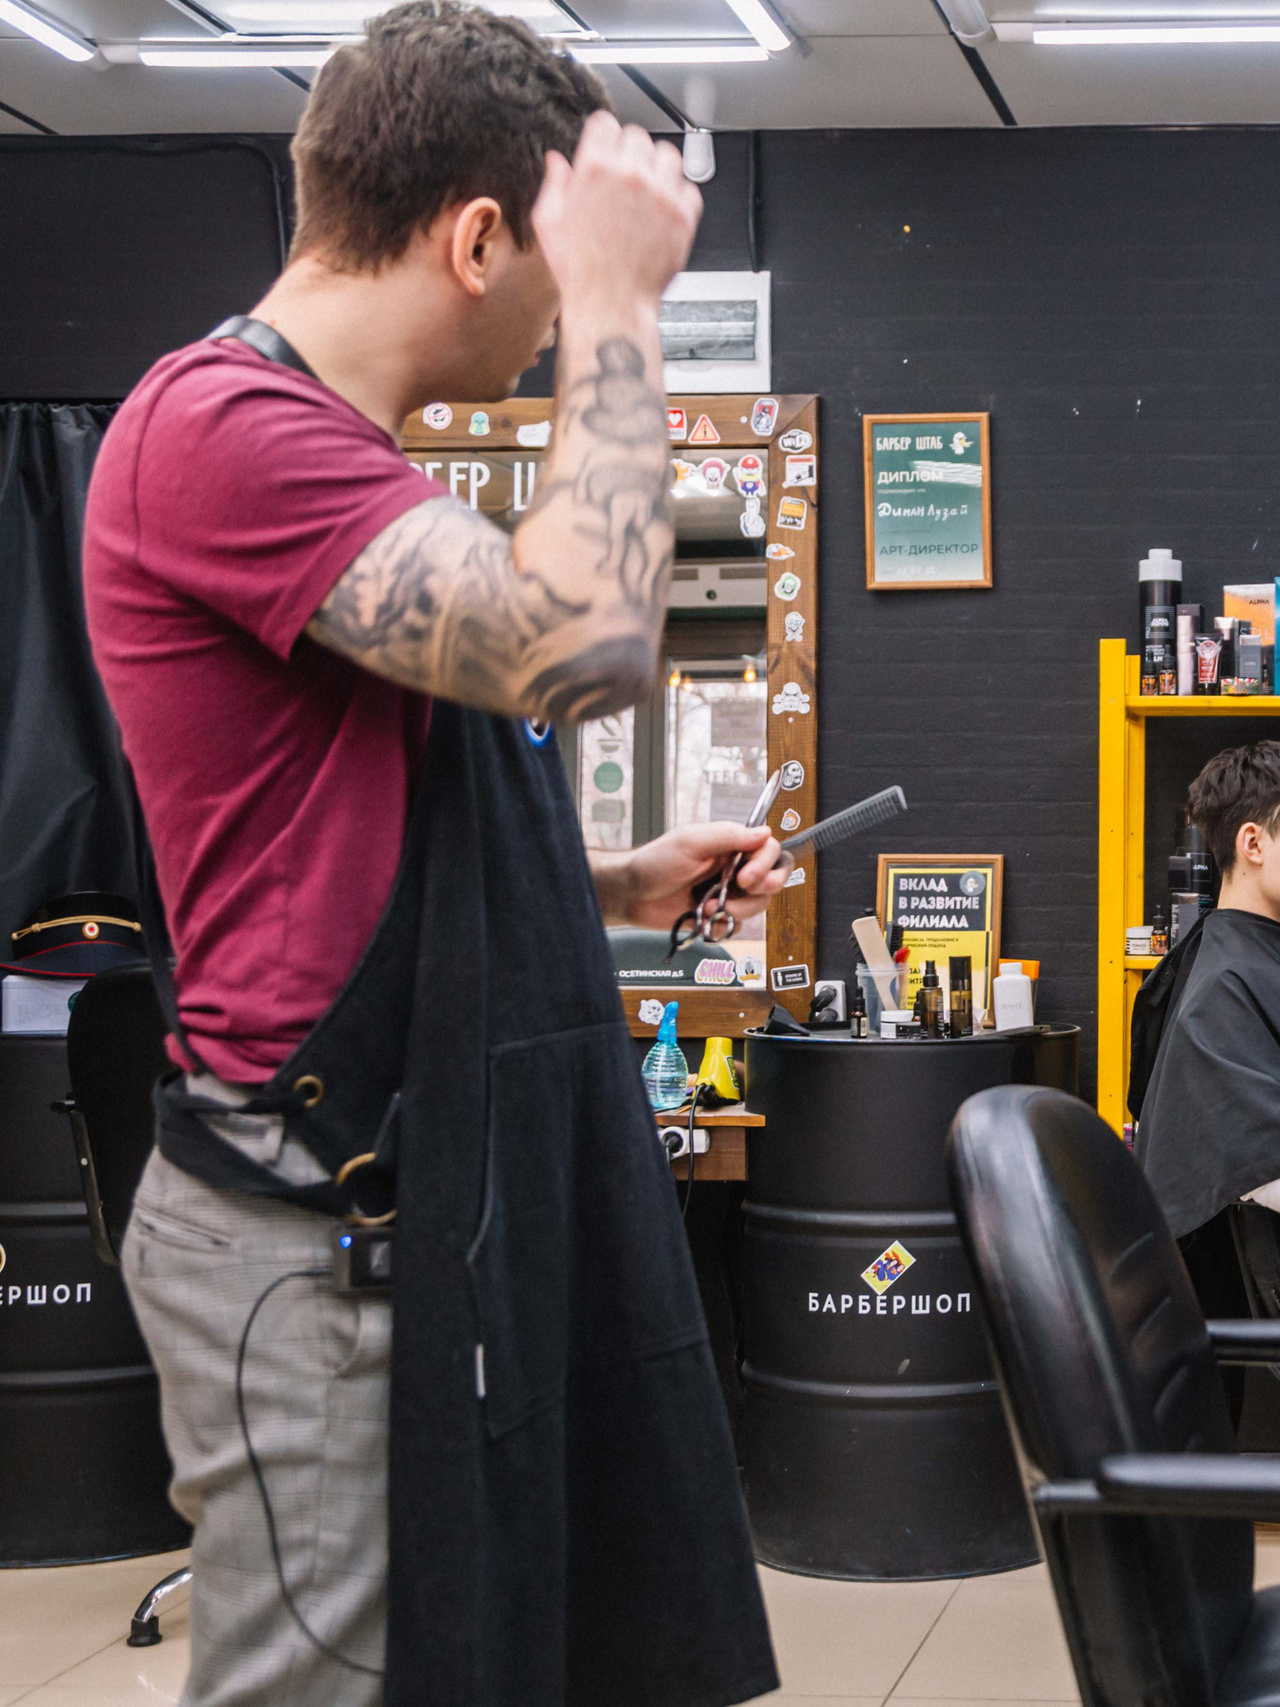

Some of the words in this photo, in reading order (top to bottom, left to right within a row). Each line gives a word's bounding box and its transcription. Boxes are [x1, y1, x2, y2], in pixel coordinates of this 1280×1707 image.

[876, 437, 912, 451] БАРБЕР
[916, 436, 943, 450] ШТАБ
[877, 470, 943, 486] ДИПЛОМ
[879, 544, 979, 556] АРТ-ДИРЕКТОР
[899, 878, 948, 892] ВКЛАД
[899, 897, 908, 910] В
[911, 896, 980, 910] РАЗВИТИЕ
[897, 914, 969, 929] ФИЛИАЛА
[619, 969, 671, 978] ОСЕТИНСКАЯ
[699, 960, 734, 982] CHILL
[808, 1292, 971, 1315] БАРБЕРШОП
